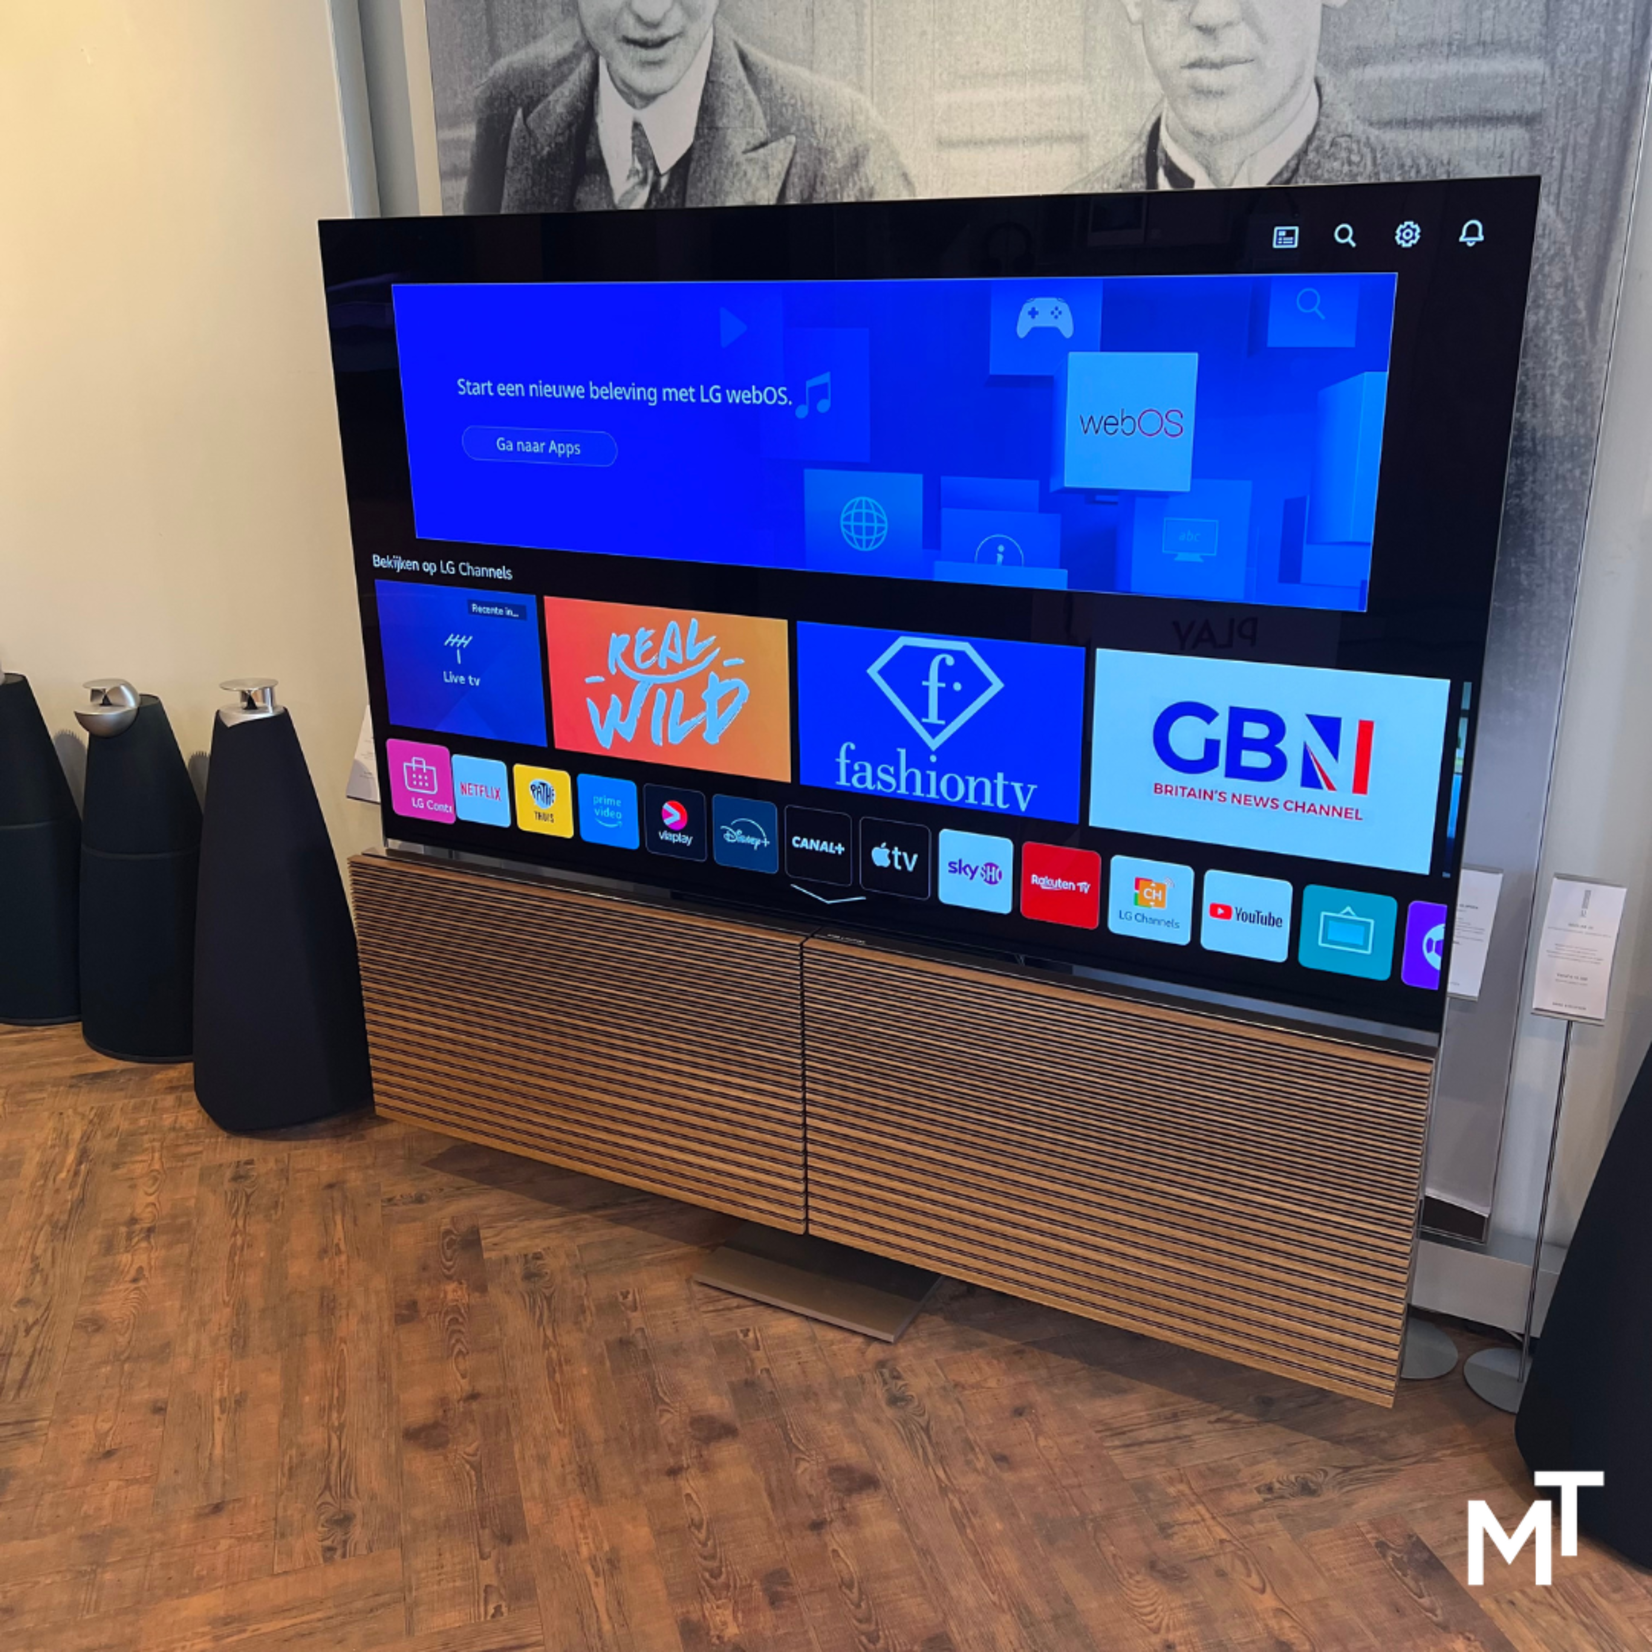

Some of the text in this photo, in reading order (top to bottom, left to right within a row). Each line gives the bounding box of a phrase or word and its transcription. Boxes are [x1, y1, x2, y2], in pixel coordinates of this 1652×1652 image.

[457, 378, 793, 406] Start een nieuwe beleving met LG webOS.
[1080, 408, 1184, 438] webOS
[496, 437, 581, 456] Ga naar Apps
[1179, 530, 1201, 542] abc
[372, 554, 513, 580] Bekijken op LG Channels
[471, 603, 504, 616] Recente
[608, 617, 719, 678] REAL
[443, 671, 480, 686] Live tv
[586, 671, 750, 749] WILD
[835, 742, 1037, 812] fashiontv
[460, 781, 502, 801] NETFLIX
[411, 796, 424, 809] LG
[593, 795, 622, 808] prime
[1153, 782, 1363, 821] BRITAIN'S NEWS CHANNEL
[594, 806, 622, 819] video
[791, 835, 845, 856] CANAL+
[891, 846, 919, 872] tv
[1031, 874, 1092, 894] Rakuten TV
[1143, 888, 1163, 901] CH
[1118, 909, 1180, 929] LG Channels
[1234, 906, 1283, 929] YouTube
